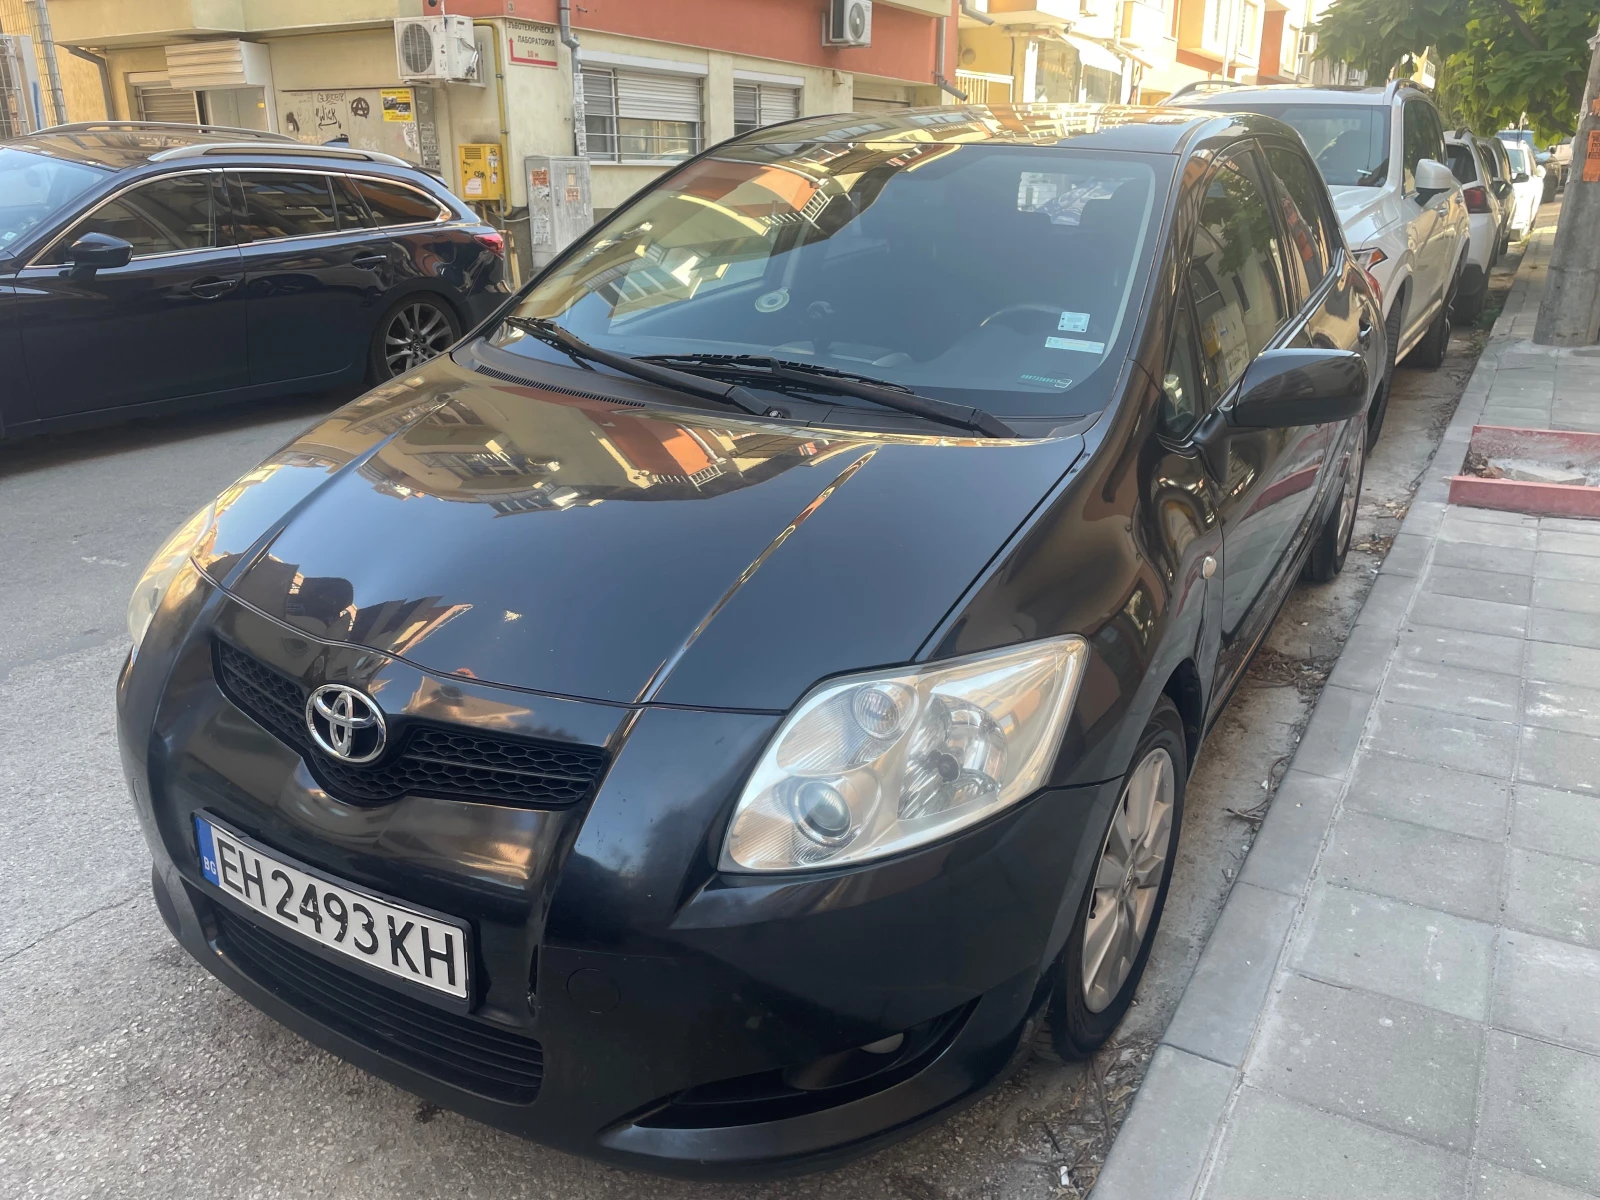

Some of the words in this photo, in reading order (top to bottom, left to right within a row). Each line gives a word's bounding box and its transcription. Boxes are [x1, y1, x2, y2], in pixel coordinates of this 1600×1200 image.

[508, 20, 554, 34] ЗЪБОТЕХНИЧЕСКА
[517, 35, 555, 47] ЛАБОРАТОРИЯ
[527, 50, 534, 58] 10
[203, 856, 217, 875] BG
